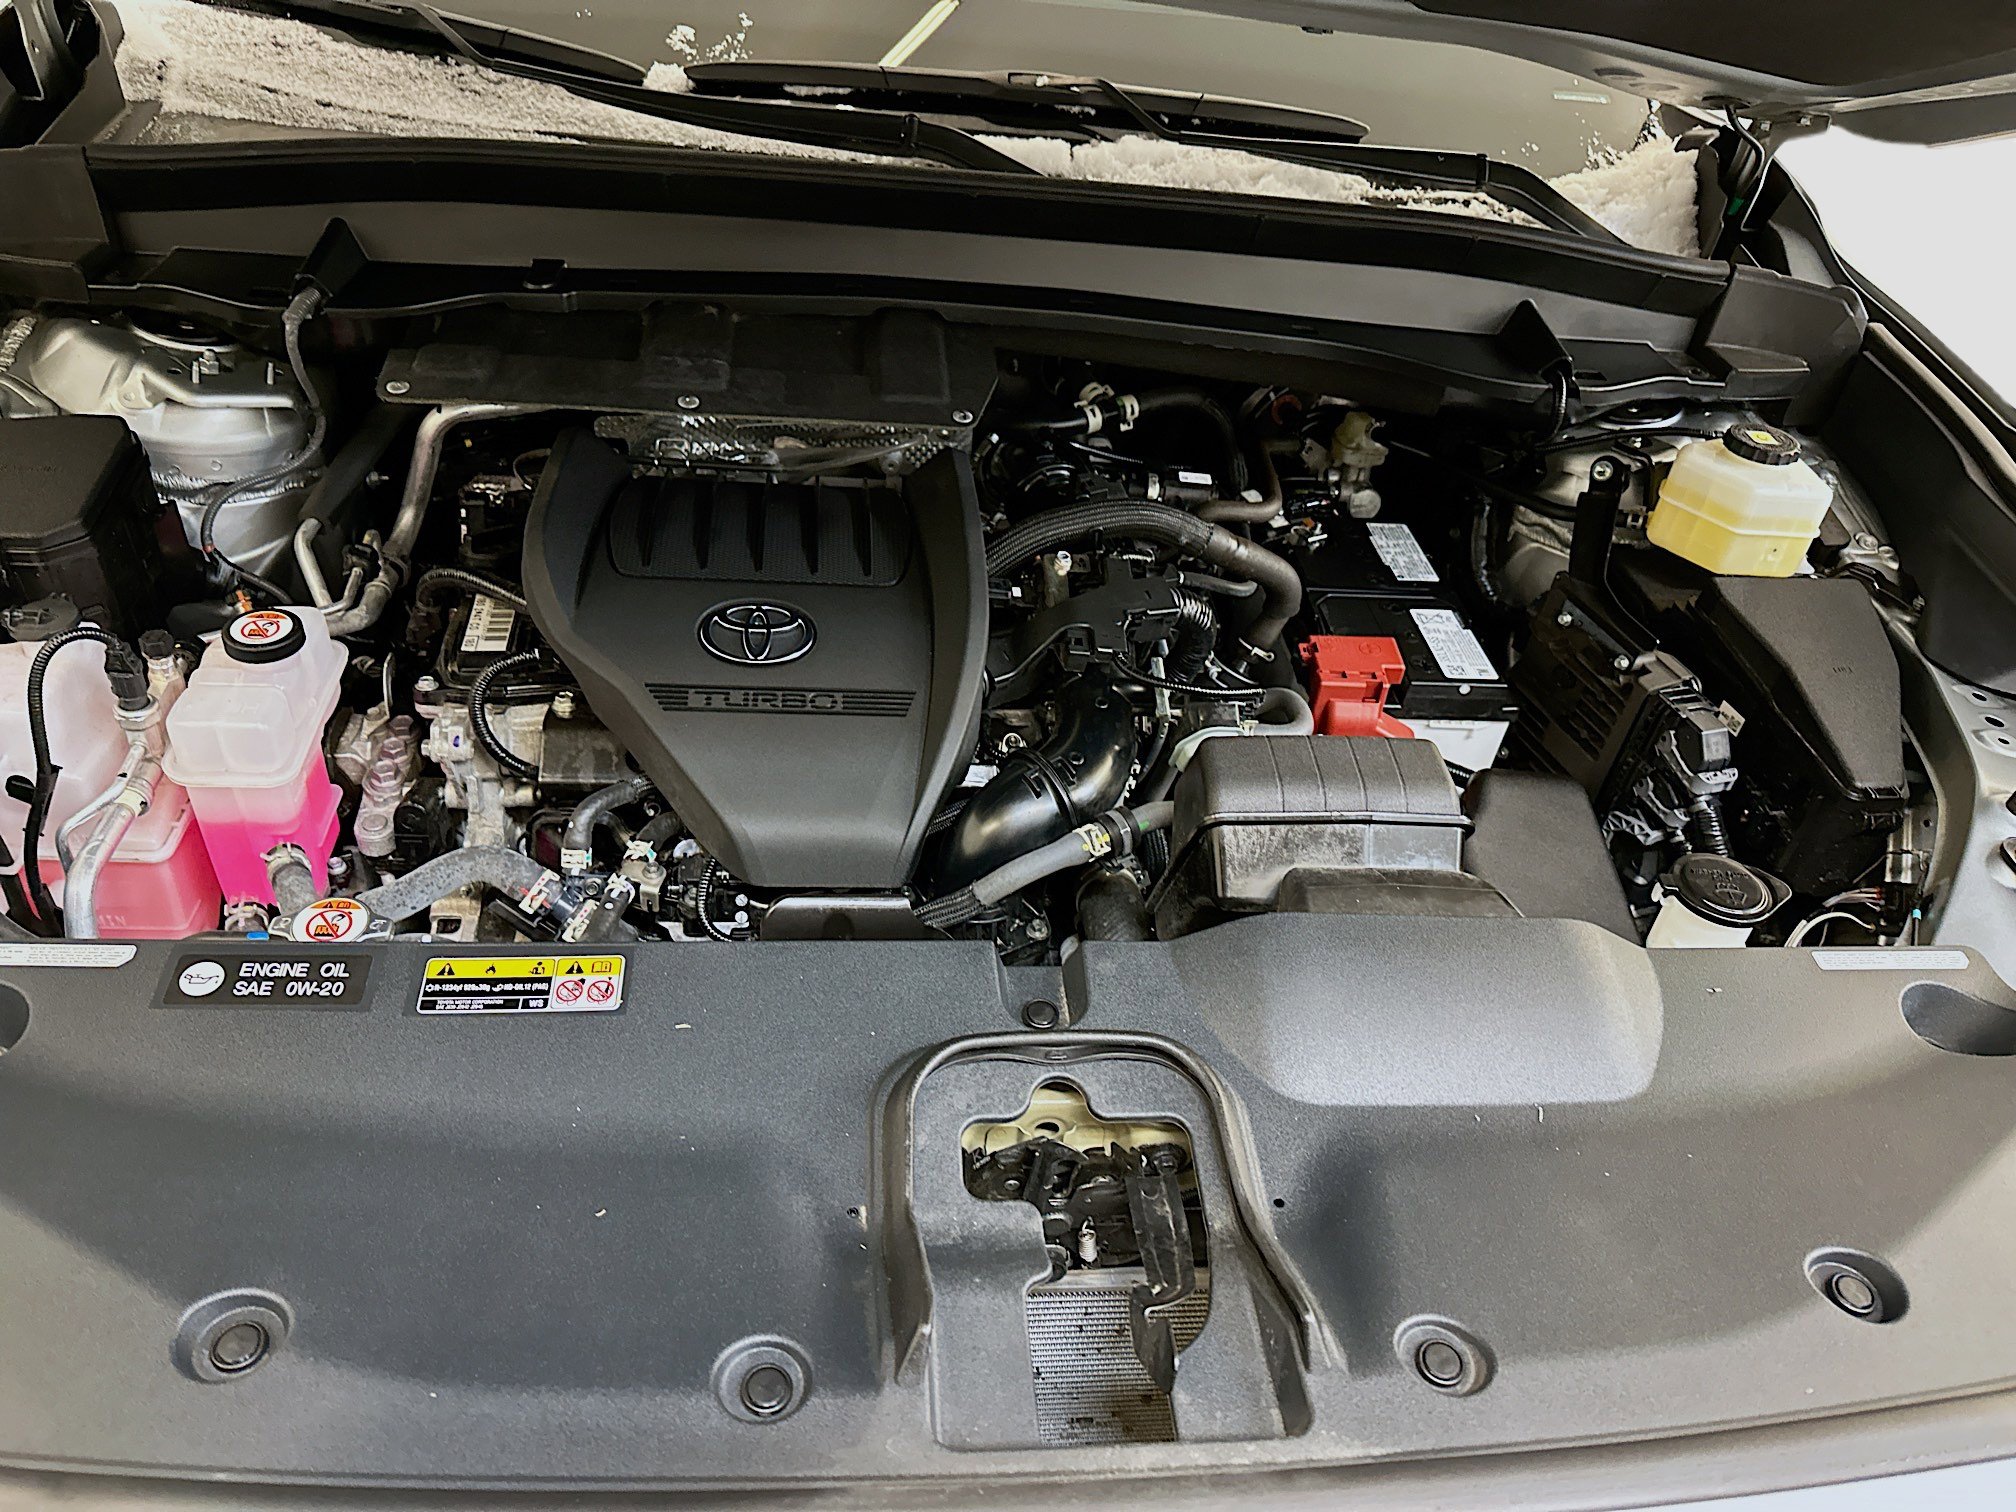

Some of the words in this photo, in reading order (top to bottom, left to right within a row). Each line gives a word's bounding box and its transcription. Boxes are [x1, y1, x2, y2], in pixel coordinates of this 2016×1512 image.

[694, 690, 838, 710] TURBO
[239, 962, 310, 978] ENGINE
[319, 962, 350, 978] OIL
[232, 981, 275, 996] SAE
[285, 981, 345, 996] 0W-20
[528, 999, 544, 1008] WS
